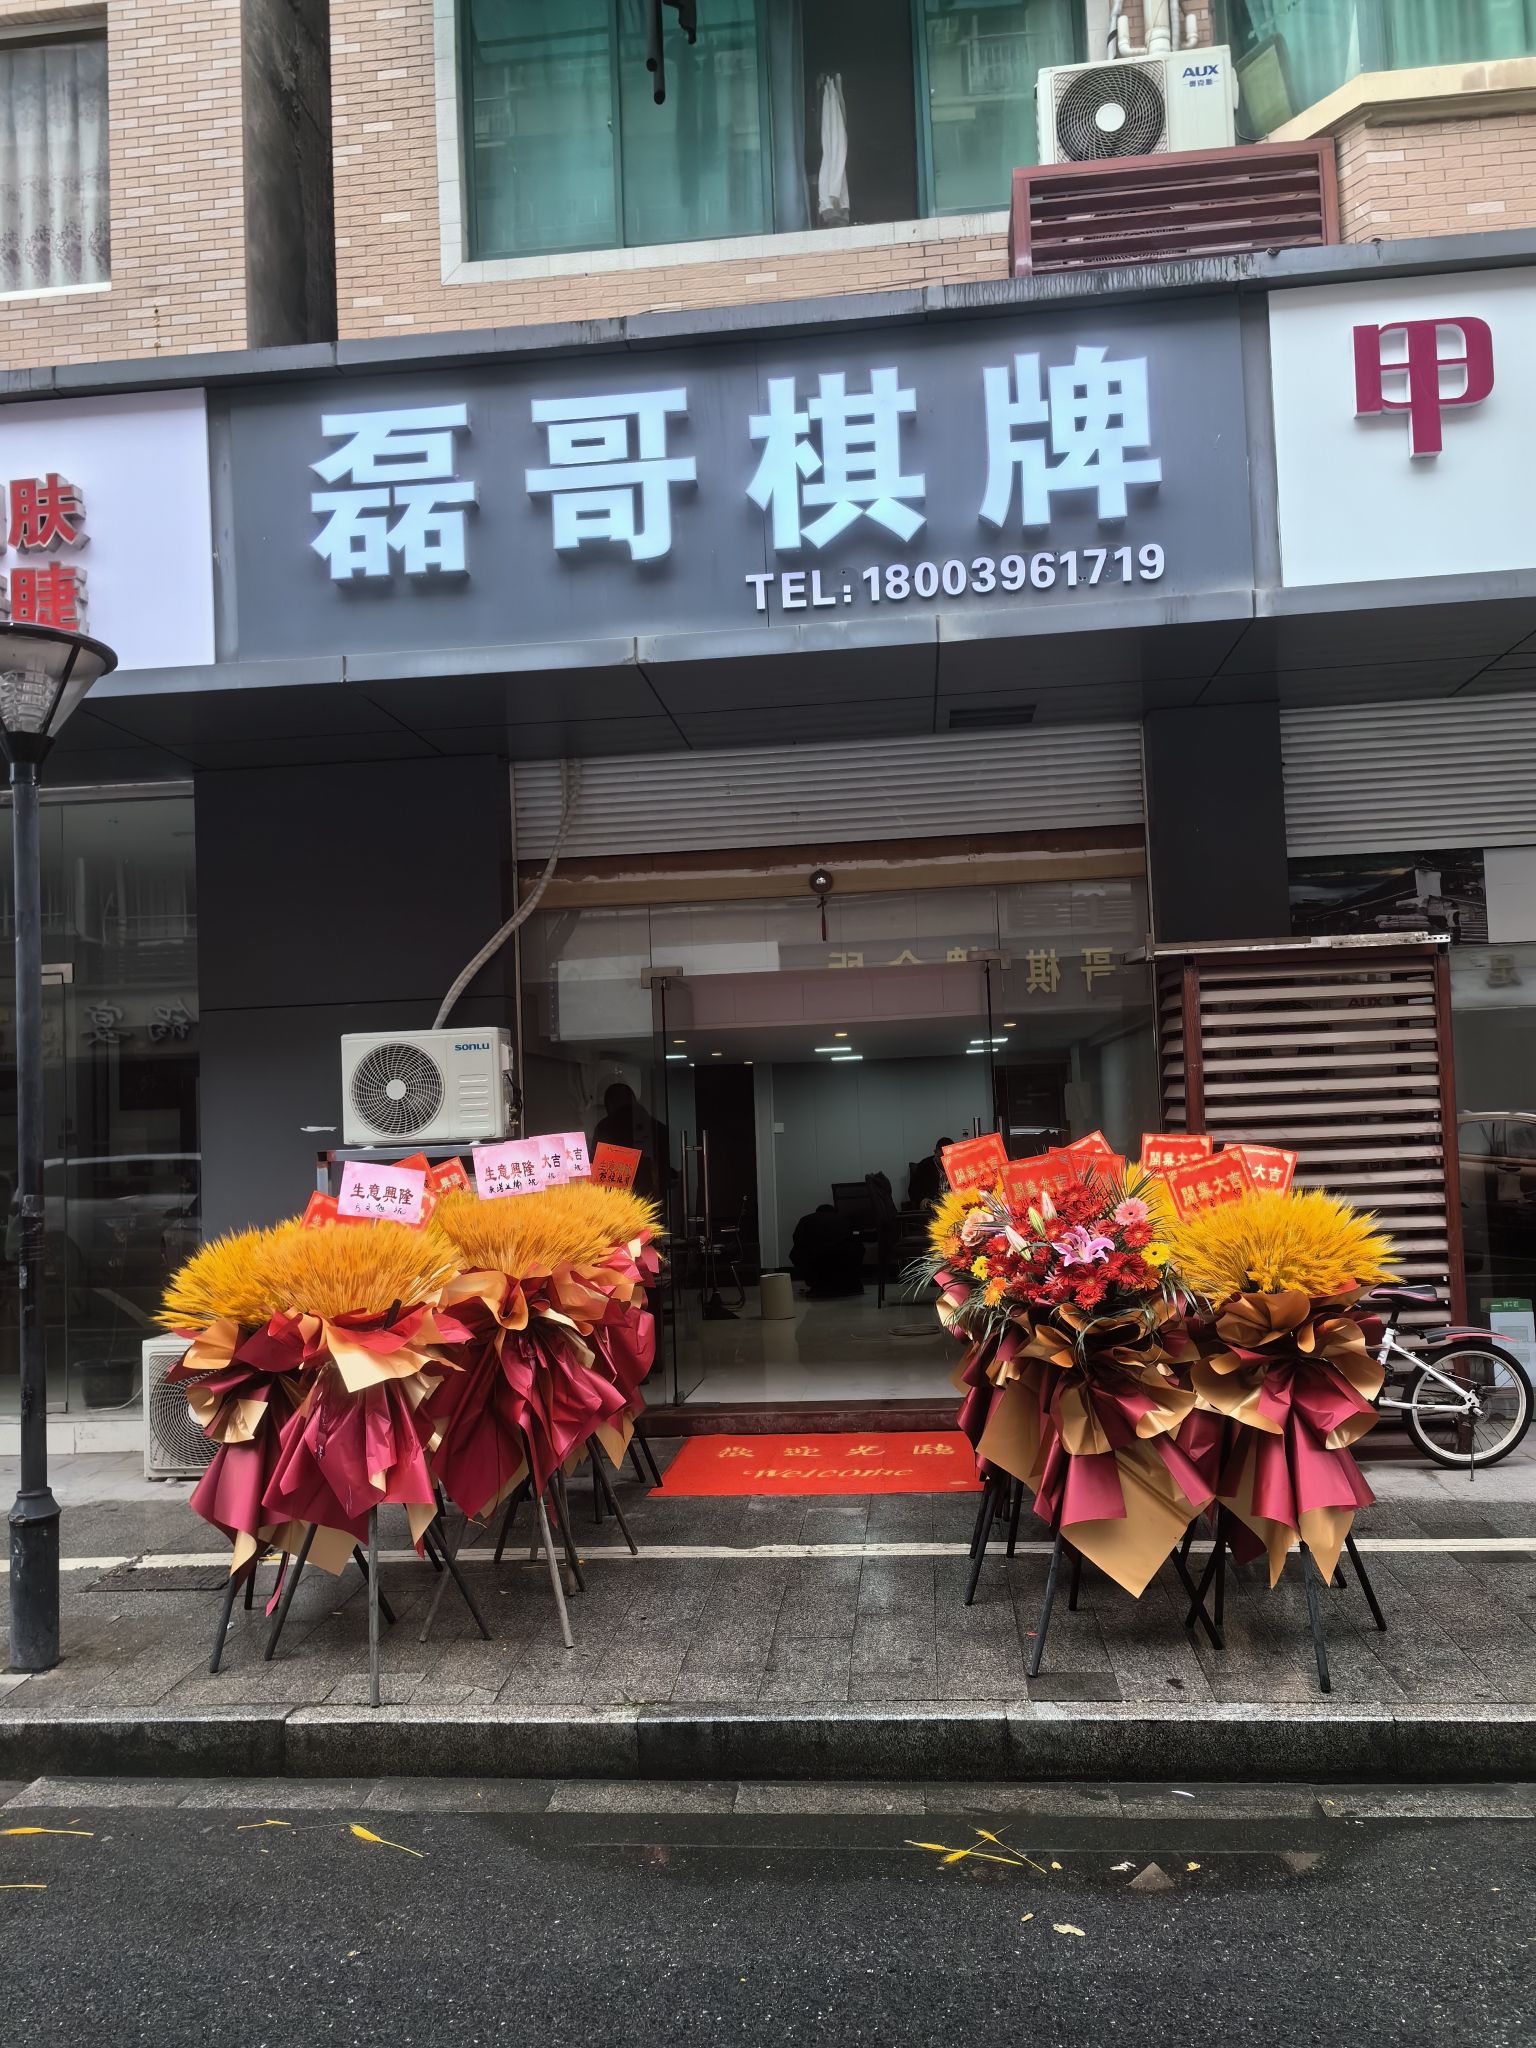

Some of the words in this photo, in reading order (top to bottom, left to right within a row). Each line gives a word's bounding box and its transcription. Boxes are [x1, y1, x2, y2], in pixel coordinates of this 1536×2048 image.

[1183, 64, 1219, 78] AUX
[1352, 316, 1494, 458] 甲
[308, 345, 1163, 580] 磊哥棋牌
[8, 473, 84, 551] 肤
[485, 1160, 535, 1182] 生意興隆
[542, 1153, 561, 1168] 大吉
[1252, 1163, 1283, 1183] 大吉
[350, 1183, 414, 1205] 生意興隆
